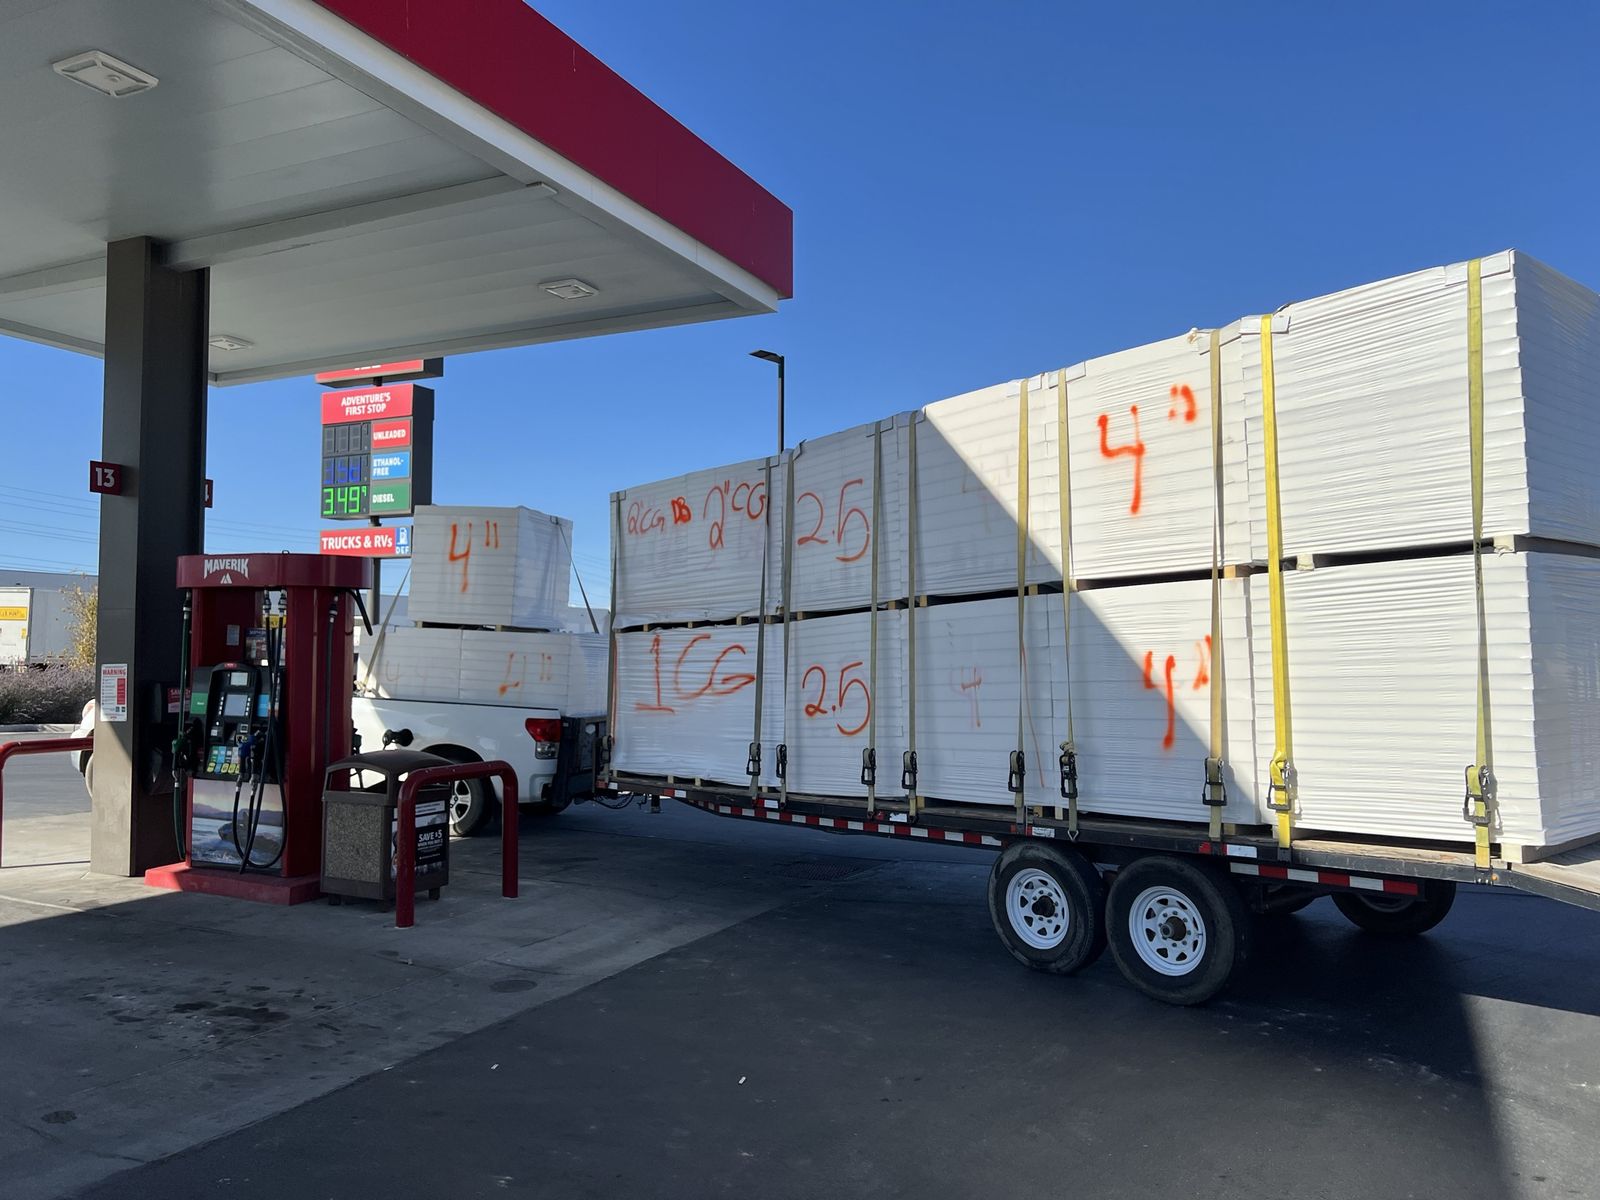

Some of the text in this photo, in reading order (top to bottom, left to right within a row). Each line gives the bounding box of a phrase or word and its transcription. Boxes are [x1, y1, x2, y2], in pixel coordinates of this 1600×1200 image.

[341, 392, 391, 407] ADVENTURE'S
[345, 402, 387, 416] FIRST STOP
[373, 429, 406, 441] UNLEADED
[373, 456, 404, 467] ETHANOL-
[95, 467, 115, 488] 13
[373, 466, 390, 477] FREE
[372, 493, 395, 504] DIESEL
[796, 478, 870, 562] 2.5
[322, 534, 393, 550] TRUCKS & RVs
[395, 546, 410, 555] DEF
[203, 558, 249, 579] MAVERIK
[802, 661, 871, 736] 2.5
[418, 832, 435, 843] SAVE
